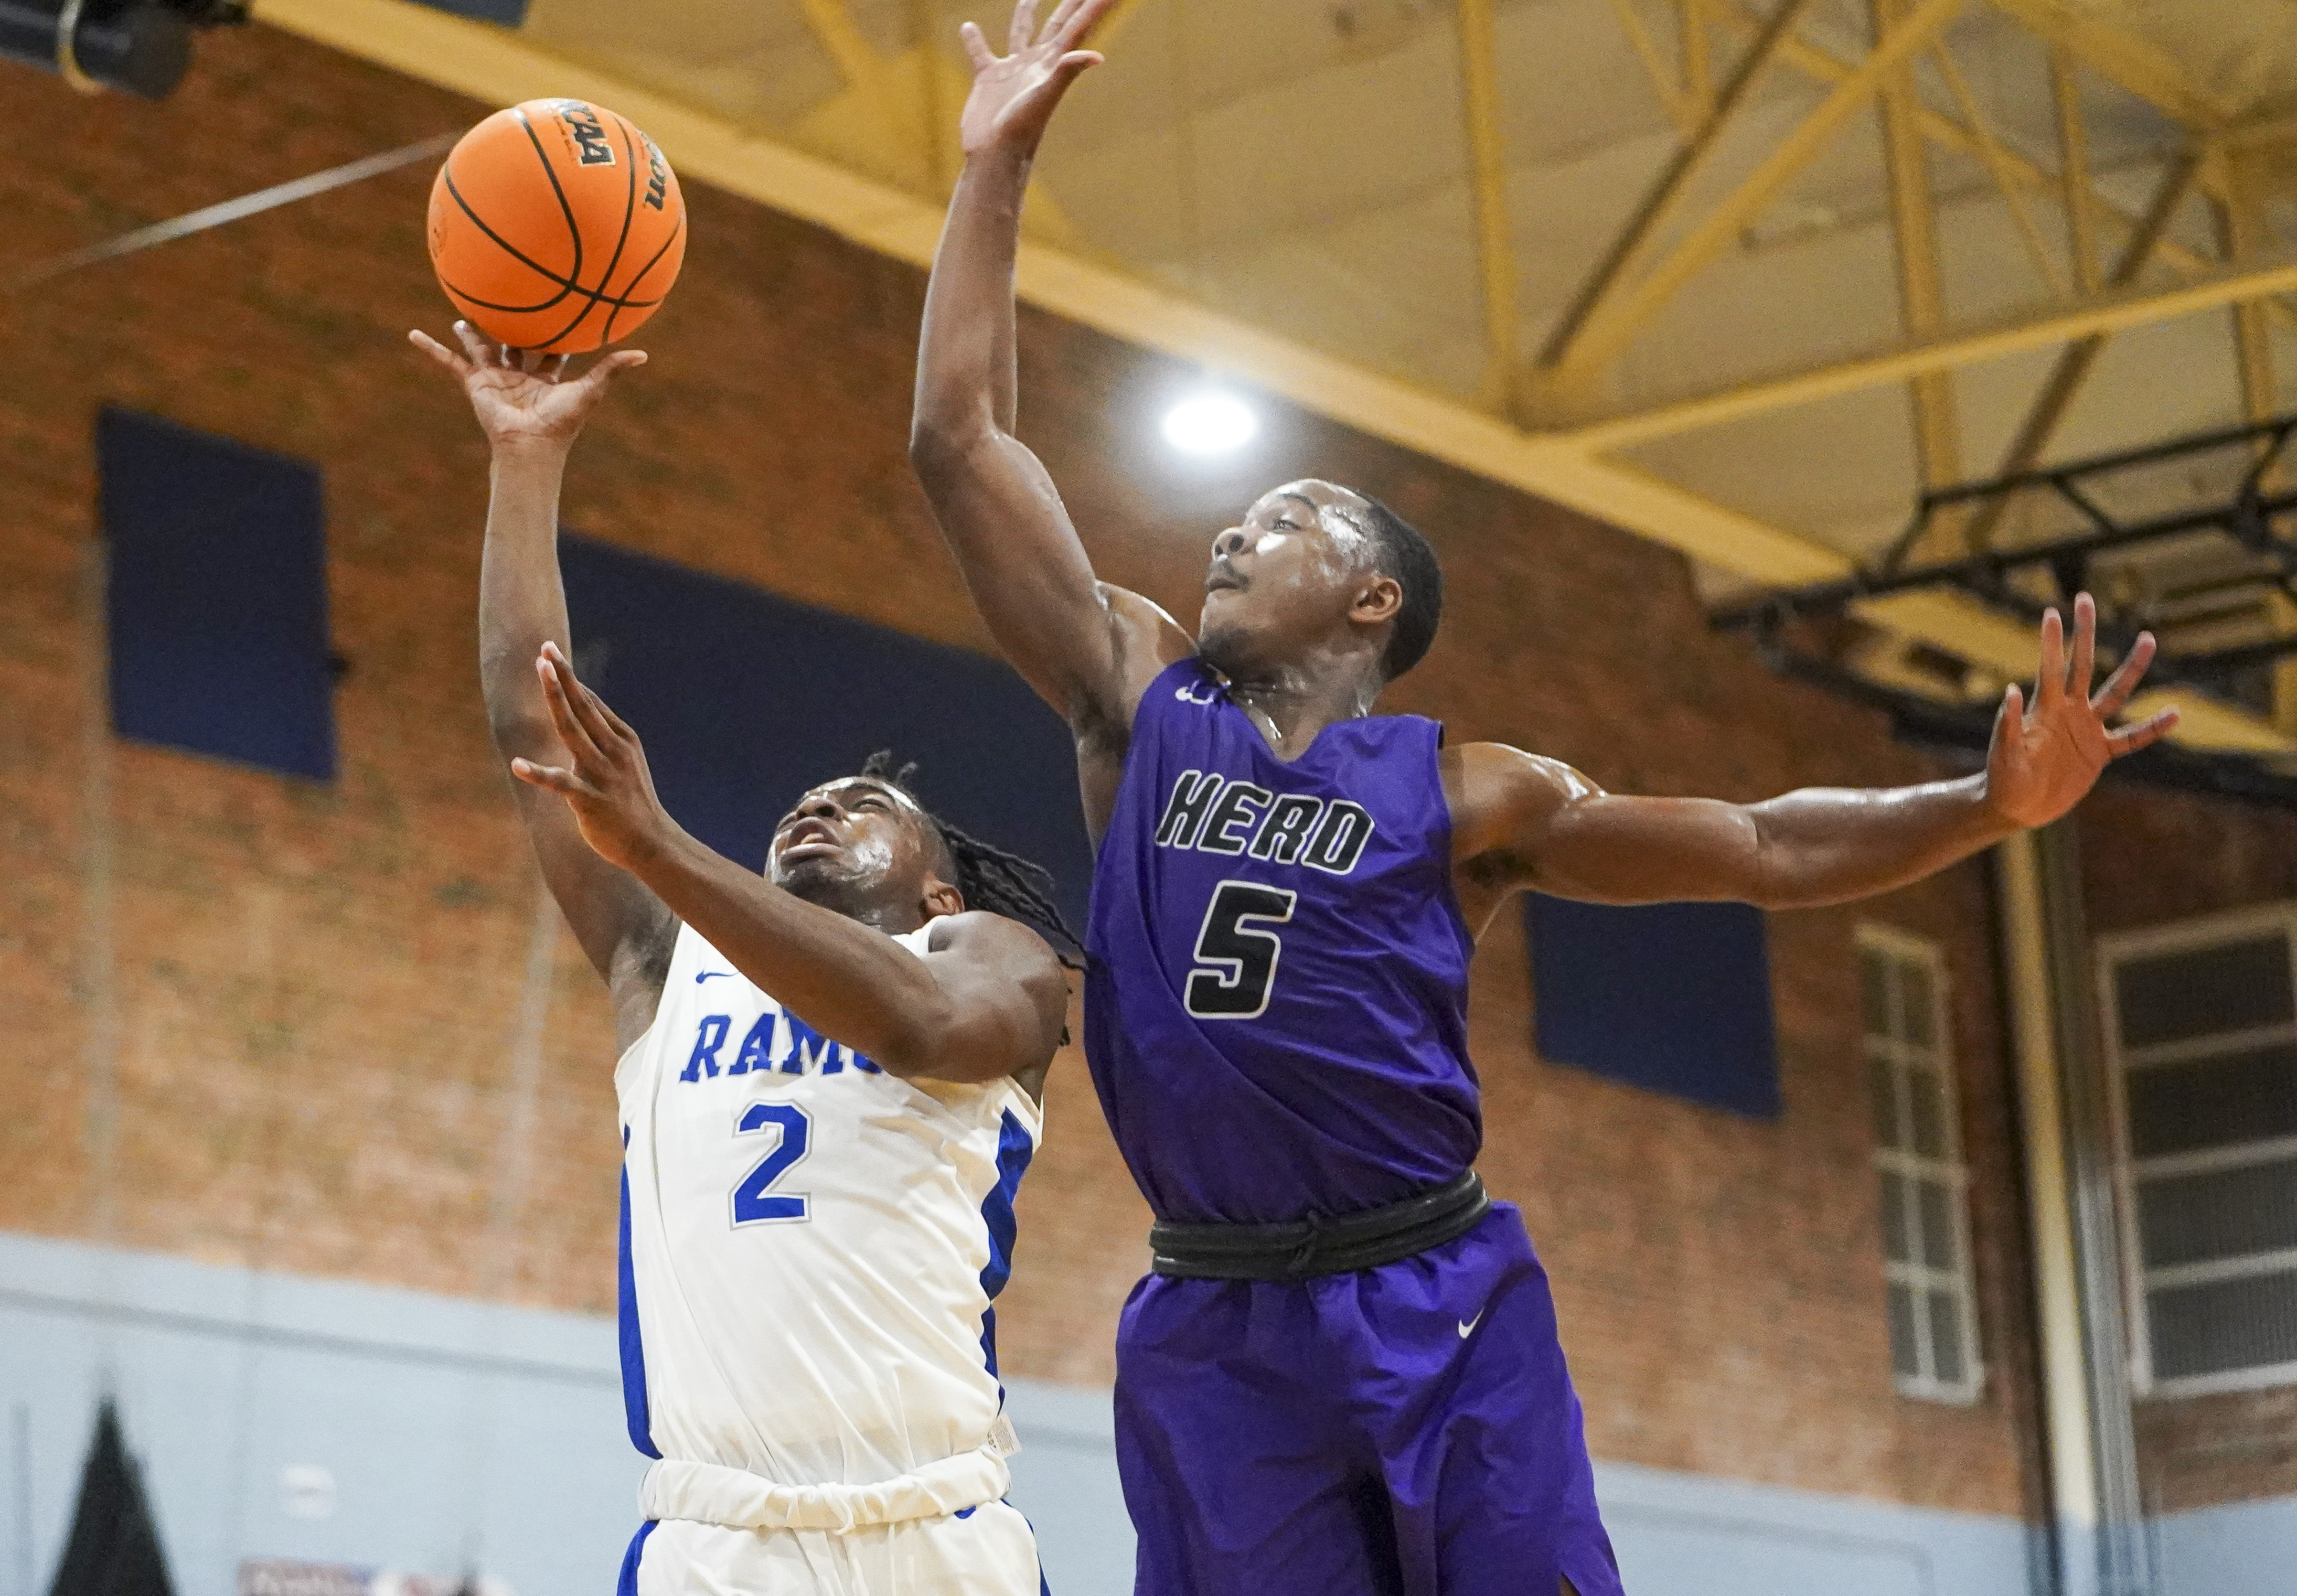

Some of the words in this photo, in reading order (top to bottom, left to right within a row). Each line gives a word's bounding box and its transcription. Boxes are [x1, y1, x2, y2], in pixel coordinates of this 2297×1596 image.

[557, 99, 616, 167] CAA
[1155, 769, 1375, 875] HERD
[1183, 880, 1297, 1019] 5
[728, 1099, 814, 1231] 2
